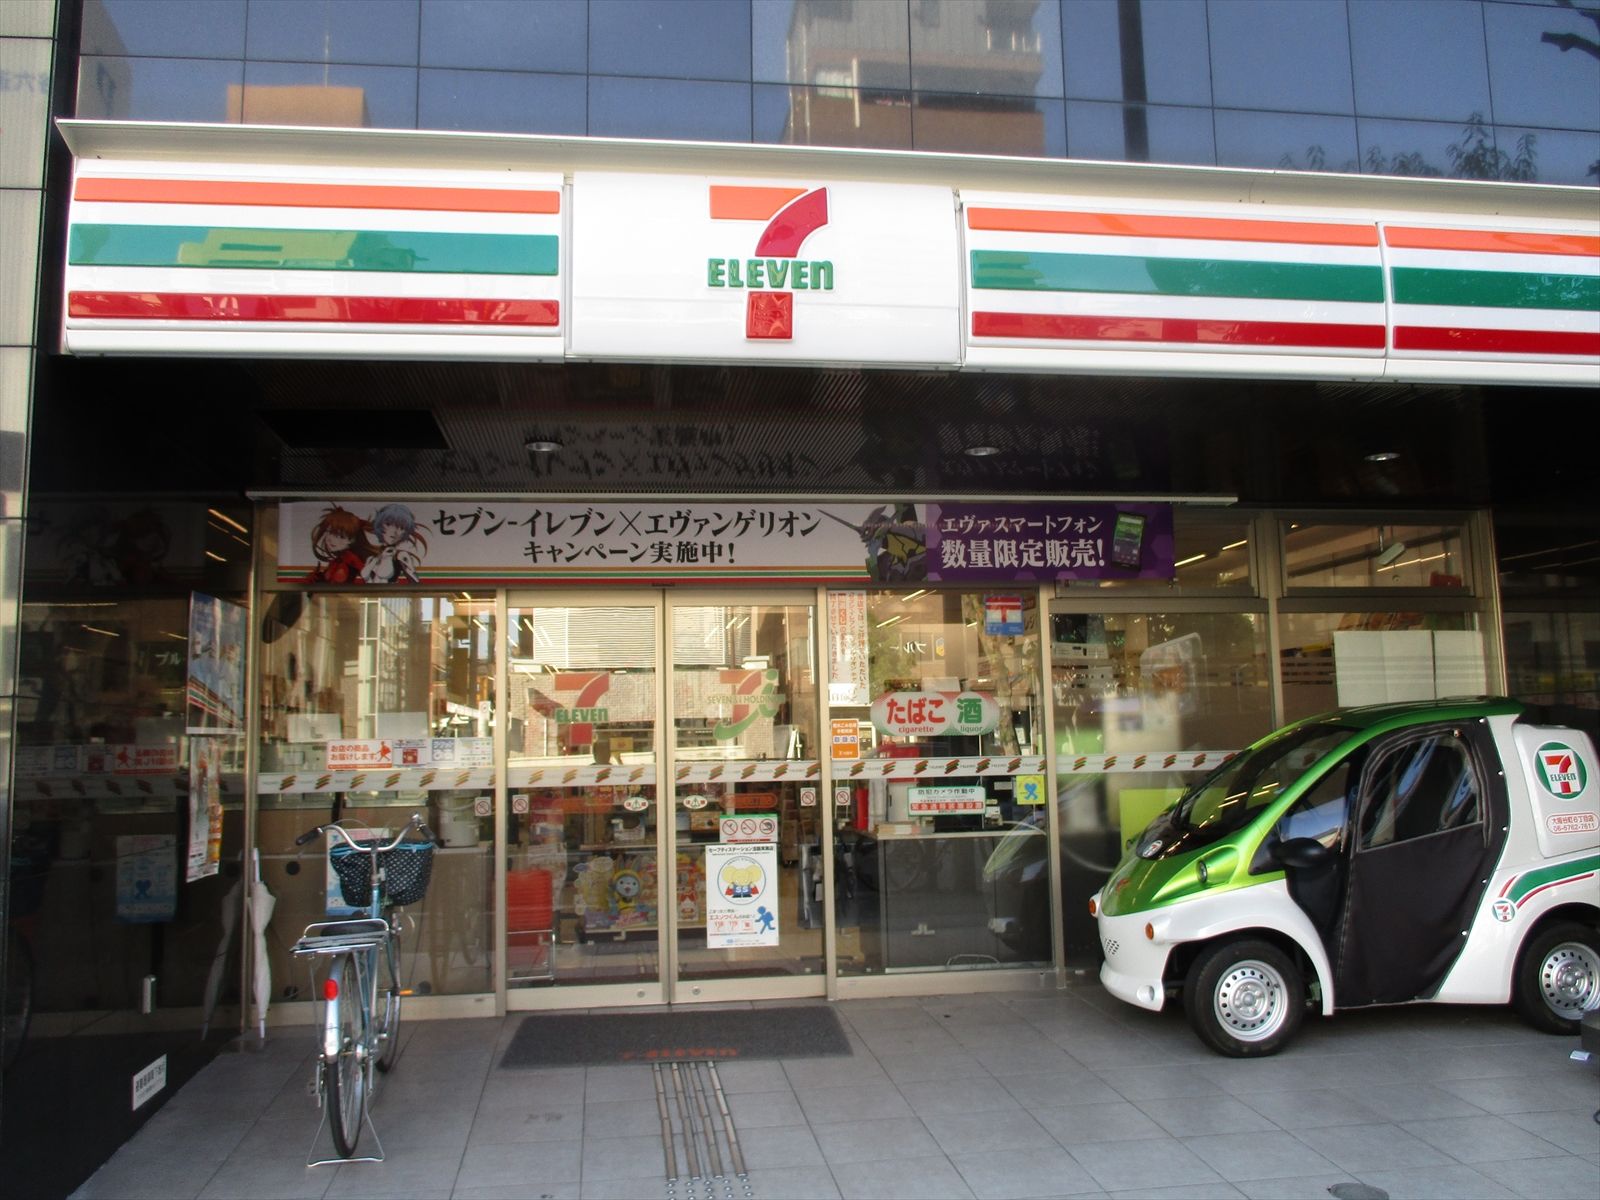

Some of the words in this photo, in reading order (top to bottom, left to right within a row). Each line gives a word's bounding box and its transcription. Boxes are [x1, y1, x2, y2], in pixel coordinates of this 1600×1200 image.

[523, 541, 735, 564] キャンペーン実施中!
[941, 538, 1105, 569] 数量限定販売!
[887, 698, 945, 724] たばこ
[957, 698, 983, 723] 酒
[898, 726, 934, 734] cigarette
[960, 725, 983, 733] liquor
